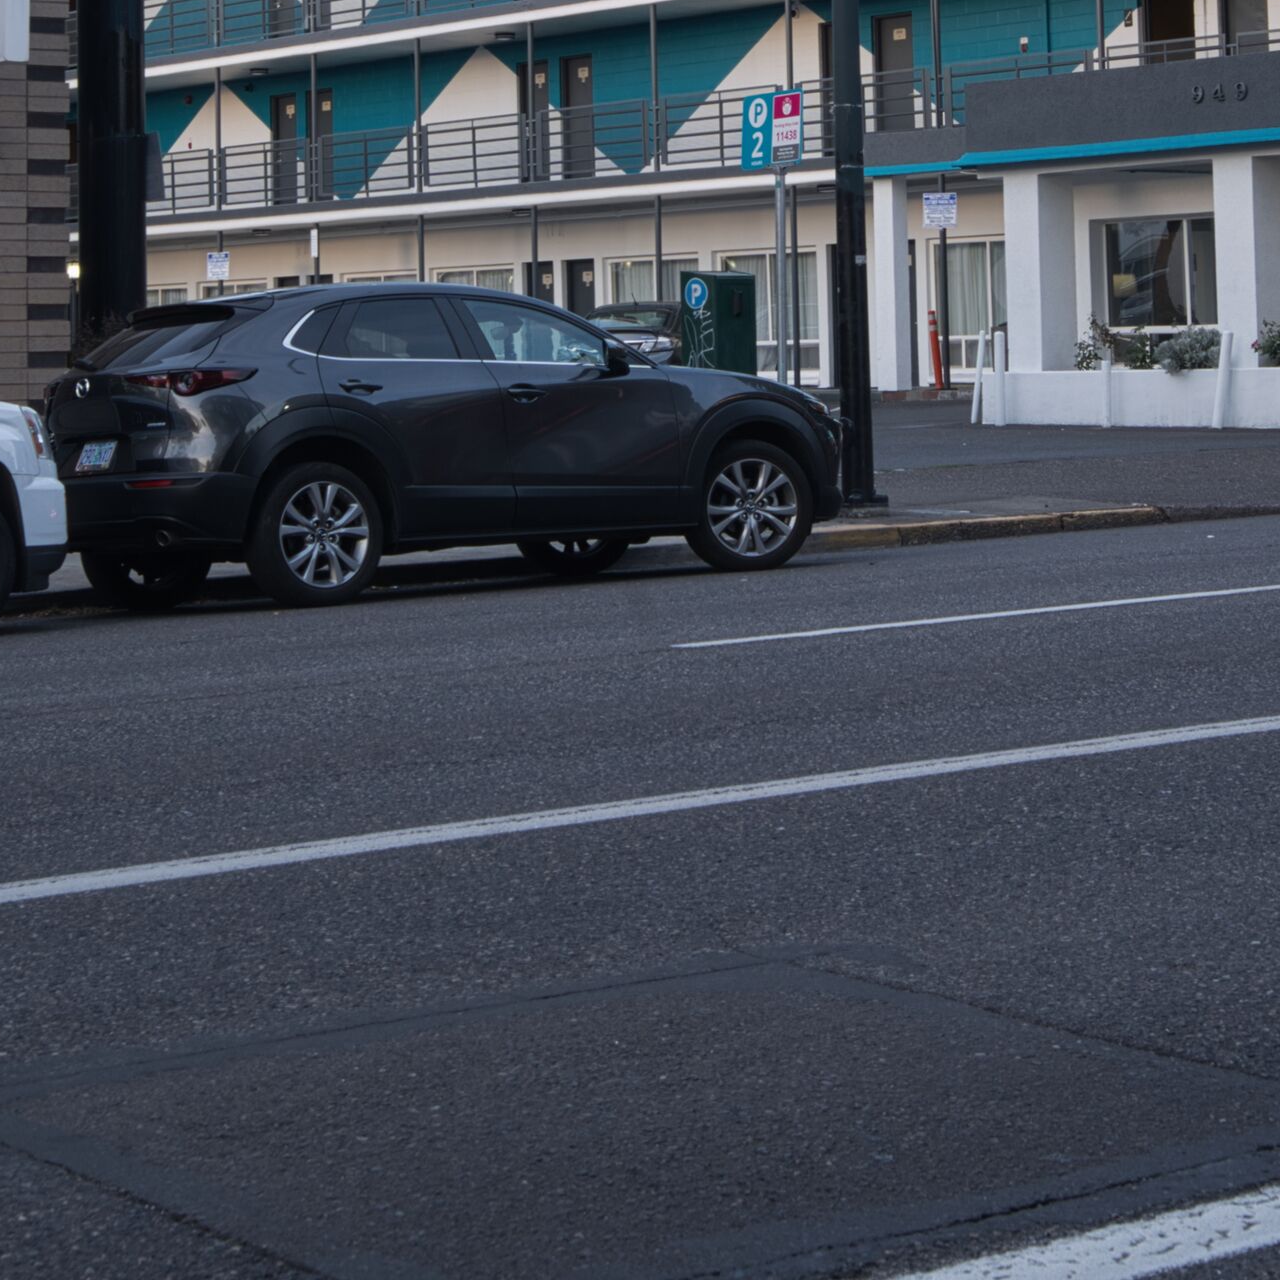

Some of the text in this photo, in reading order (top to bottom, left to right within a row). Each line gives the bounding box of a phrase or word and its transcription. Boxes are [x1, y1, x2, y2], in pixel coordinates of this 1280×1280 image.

[1191, 81, 1249, 104] 949
[753, 102, 764, 124] P
[751, 131, 764, 159] 2
[776, 129, 798, 142] 11438
[691, 284, 702, 305] P
